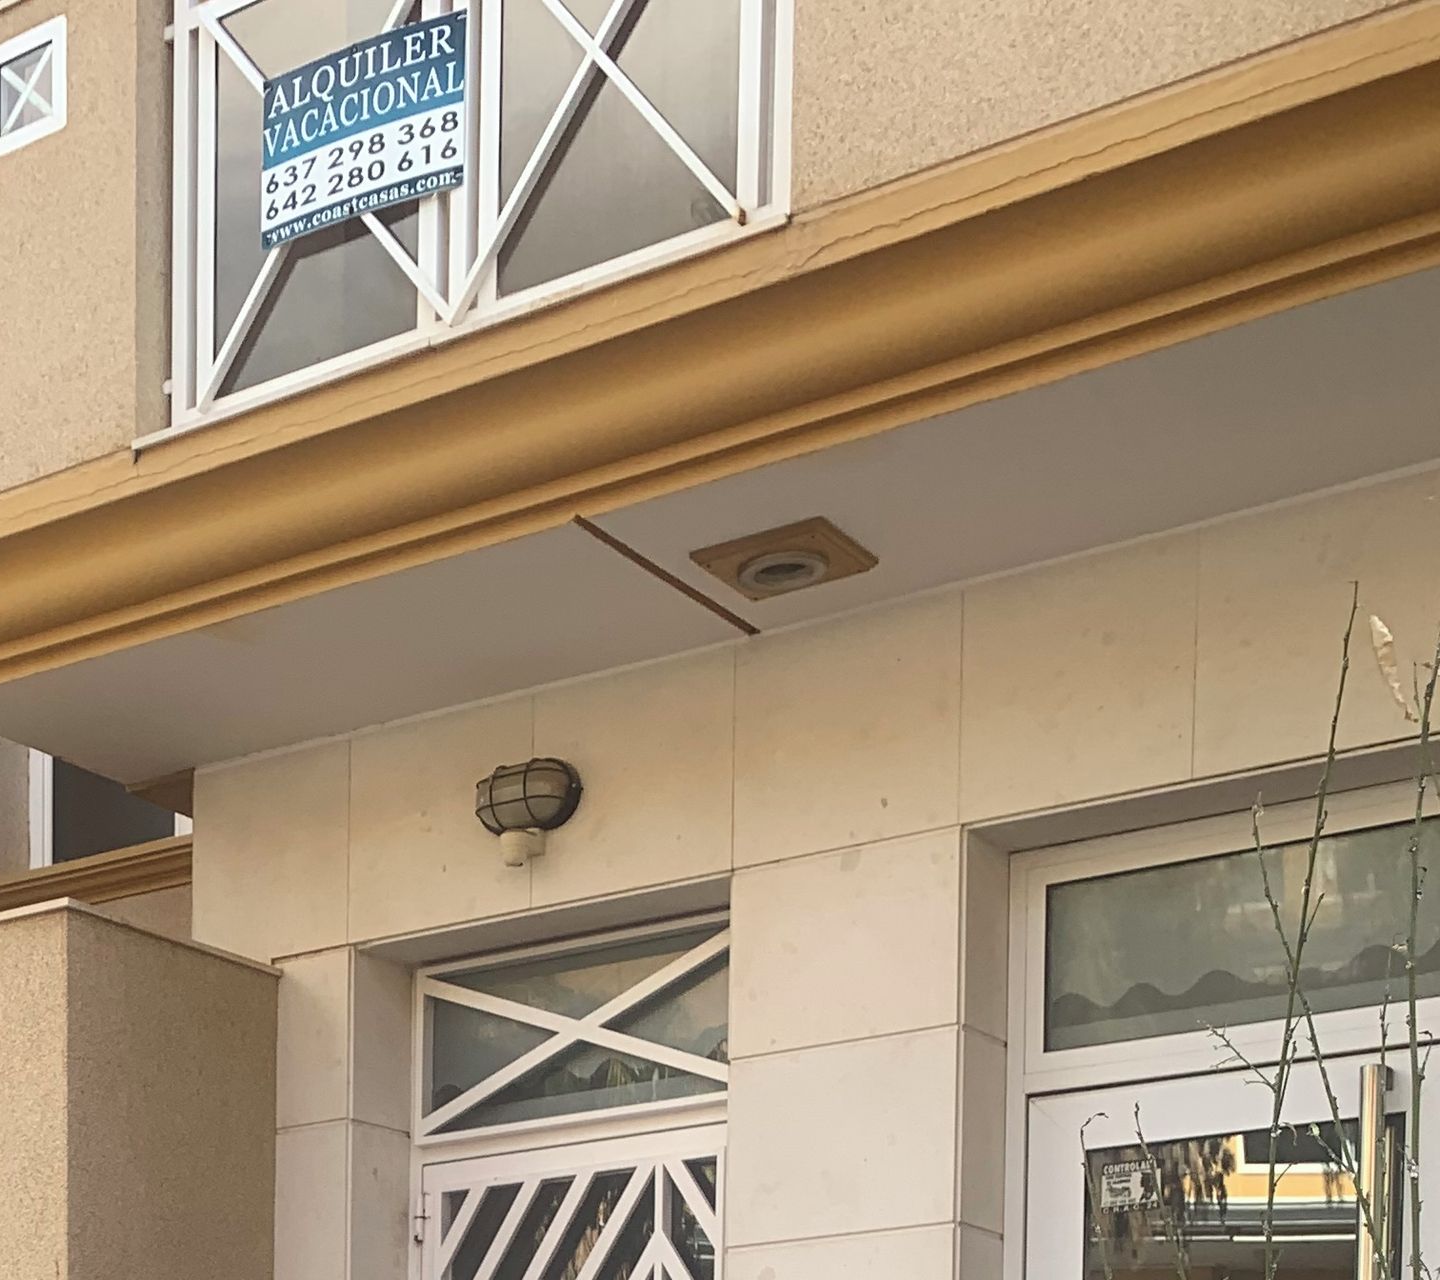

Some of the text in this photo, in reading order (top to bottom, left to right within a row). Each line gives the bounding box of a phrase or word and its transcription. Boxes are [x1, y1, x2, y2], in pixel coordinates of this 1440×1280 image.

[263, 61, 464, 158] VACACIONAL
[267, 23, 455, 119] ALQUILER
[266, 111, 458, 194] 637 298 368
[266, 138, 457, 220] 642 280 616
[265, 171, 457, 245] www.coastcasas.com
